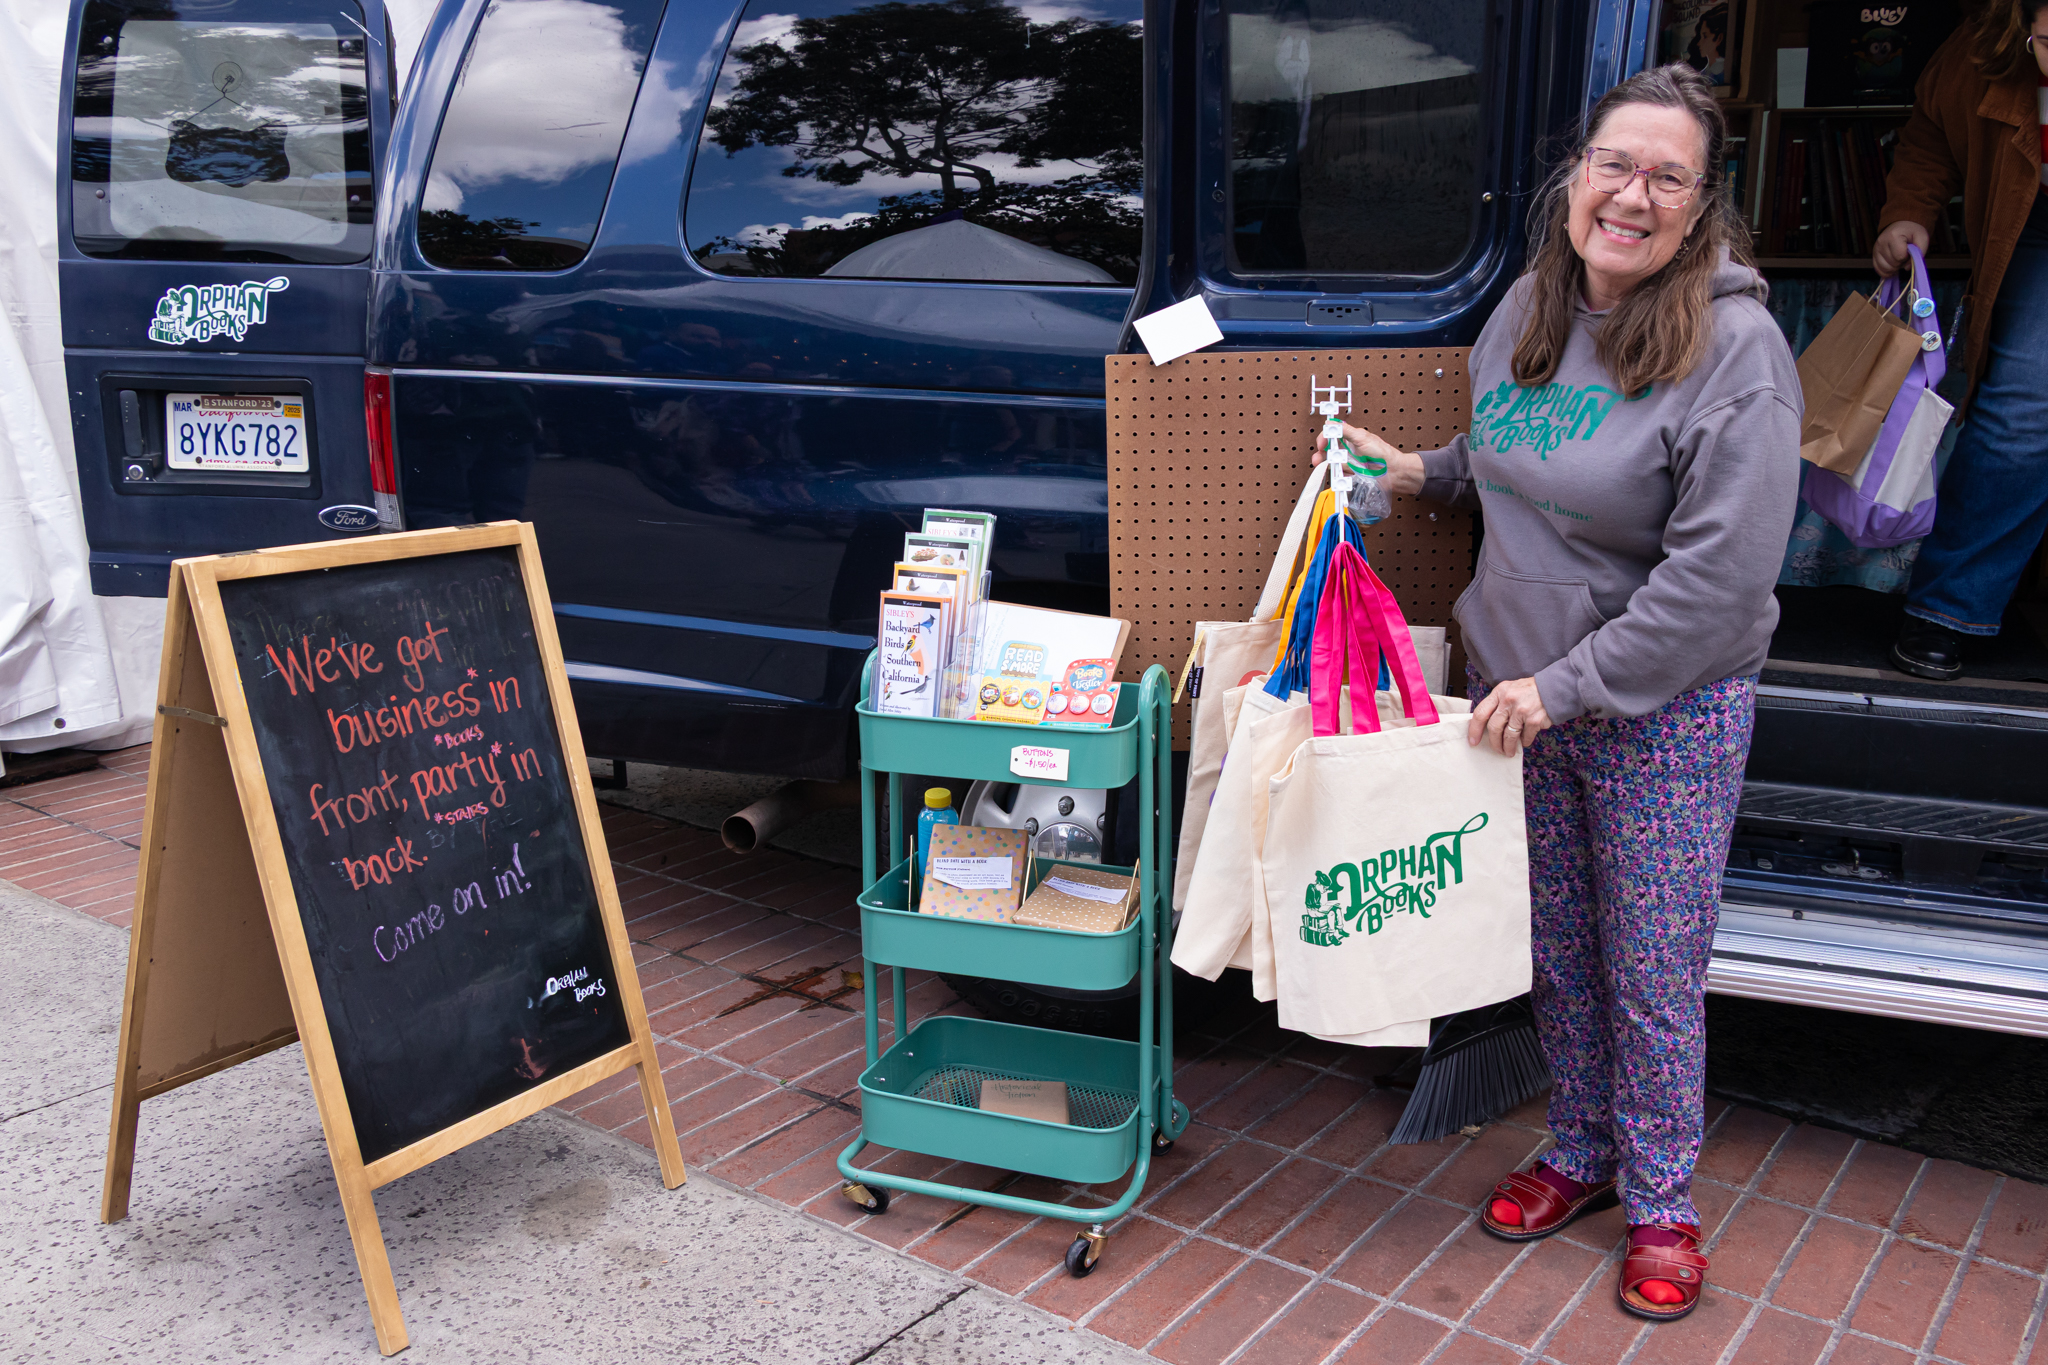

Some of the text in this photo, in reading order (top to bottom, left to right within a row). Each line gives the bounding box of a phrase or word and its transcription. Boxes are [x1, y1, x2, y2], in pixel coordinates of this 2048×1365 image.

[1860, 6, 1908, 26] BLUEY
[179, 277, 289, 326] ORPHAN
[191, 314, 247, 342] BOOKS
[174, 402, 192, 412] MAR
[210, 399, 273, 409] STANFORD '23
[1489, 382, 1653, 441] ORPHAN
[180, 422, 298, 458] 8YKG782
[1491, 424, 1568, 461] BOOKS
[334, 510, 367, 526] Ford
[1554, 502, 1593, 521] home
[886, 608, 915, 618] SIBLEY'S
[885, 620, 921, 634] Backyard
[884, 637, 905, 649] Birds
[1004, 647, 1043, 662] READ
[265, 635, 383, 696] We've
[396, 621, 449, 693] got
[886, 653, 921, 667] Southern
[1000, 660, 1041, 674] S'MORE
[882, 669, 921, 683] California
[487, 668, 523, 713] in
[1022, 748, 1054, 757] BUTTONS
[309, 769, 409, 837] front,
[508, 741, 544, 782] in
[342, 836, 429, 891] back.
[1327, 812, 1489, 922] ORPHAN
[373, 841, 533, 963] Come on in!
[1356, 881, 1436, 936] BOOKS
[546, 966, 589, 996] ORPHAN
[573, 978, 606, 1002] BOOKS
